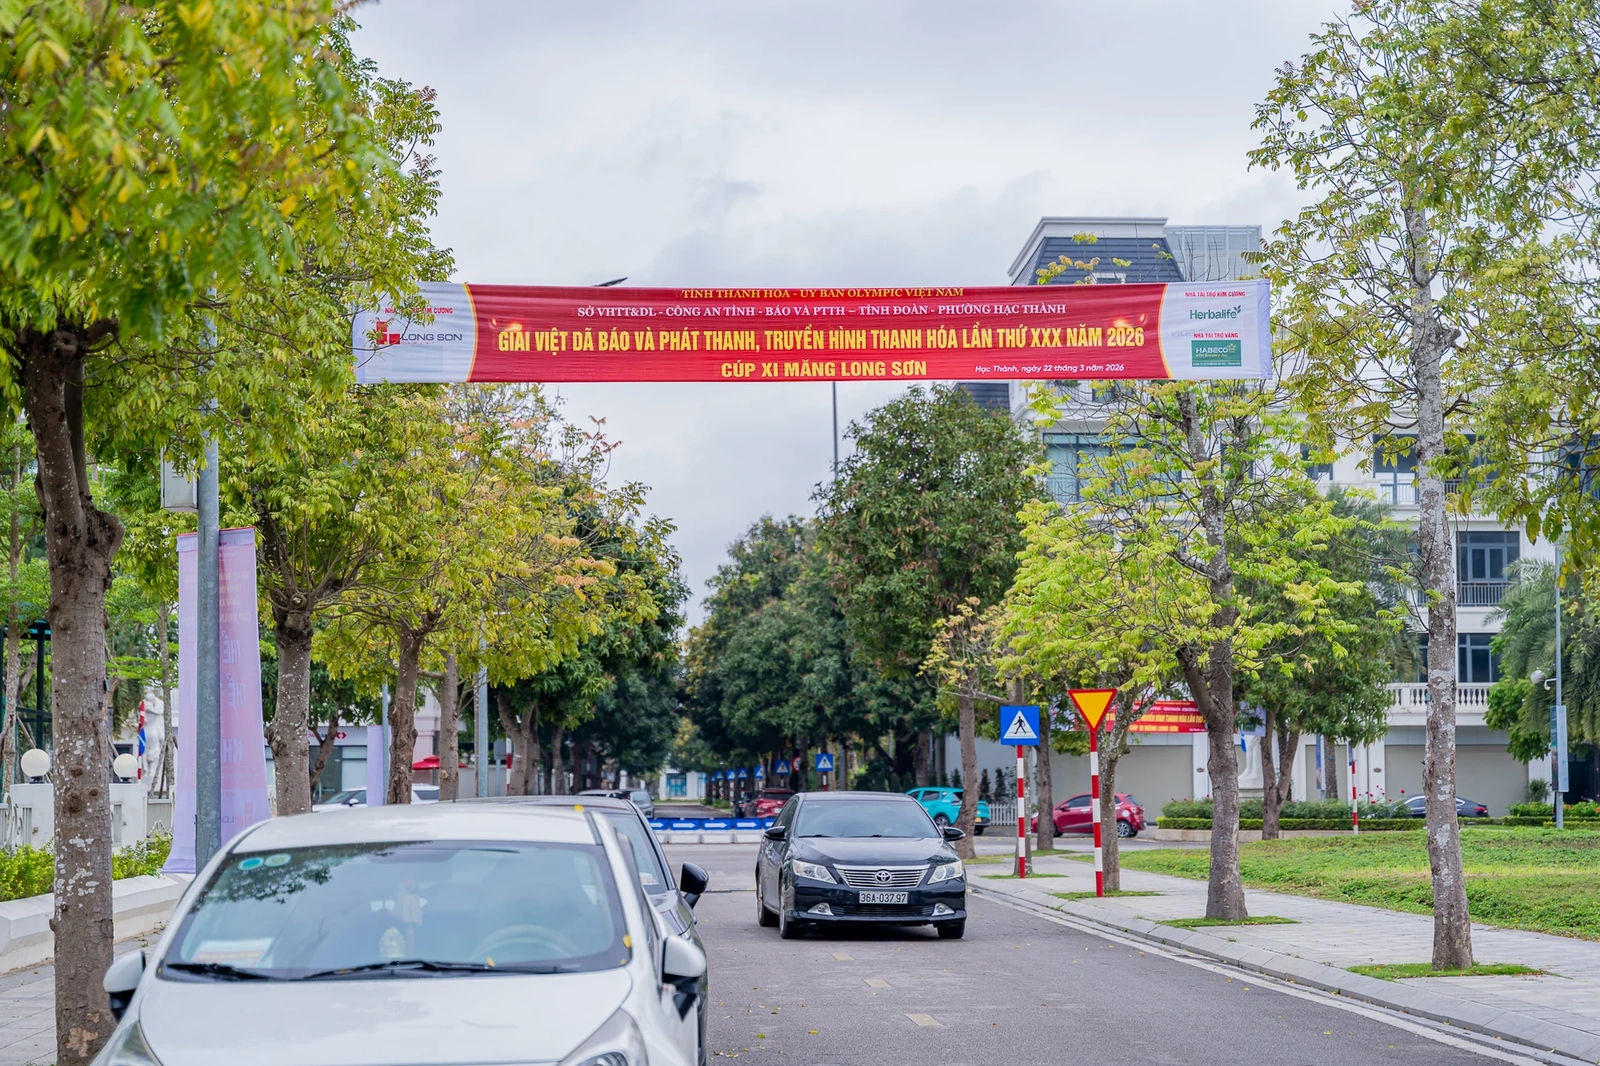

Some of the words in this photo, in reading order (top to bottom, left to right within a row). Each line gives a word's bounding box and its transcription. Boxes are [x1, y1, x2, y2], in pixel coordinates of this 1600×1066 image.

[716, 289, 760, 299] THANH
[820, 288, 845, 298] BAN
[847, 288, 903, 298] OLYMPIC
[936, 287, 964, 297] NAM
[598, 307, 656, 317] VHTT&DL
[666, 305, 700, 317] CÔNG
[704, 307, 721, 316] AN
[766, 305, 790, 316] BÁO
[794, 304, 810, 316] VÀ
[813, 306, 845, 316] PTTH
[893, 303, 928, 315] ĐOÀN
[938, 303, 991, 315] PHƯỜNG
[993, 304, 1020, 316] HẠC
[1022, 302, 1066, 314] THÀNH
[1189, 308, 1237, 320] Herbalife
[402, 333, 435, 341] LONG
[437, 333, 463, 341] SON
[535, 327, 568, 356] VIỆT
[572, 327, 594, 351] DÃ
[598, 326, 630, 351] BÁO
[634, 326, 655, 351] VÀ
[659, 326, 700, 351] PHÁT
[704, 330, 760, 353] THANH,
[764, 323, 824, 350] TRUYỀN
[829, 325, 866, 350] HÌNH
[871, 329, 922, 349] THANH
[926, 324, 958, 349] HÓA
[963, 321, 992, 349] LẦN
[997, 323, 1028, 348] THỨ
[1031, 327, 1063, 348] XXX
[1066, 323, 1103, 347] NĂM
[1107, 327, 1145, 347] 2026
[721, 359, 756, 378] CÚP
[761, 363, 779, 378] XI
[784, 359, 836, 377] MĂNG
[842, 362, 886, 377] LONG
[891, 359, 927, 377] SƠN
[975, 365, 991, 374] Hạc
[1021, 365, 1041, 374] ngày
[1054, 364, 1077, 373] tháng
